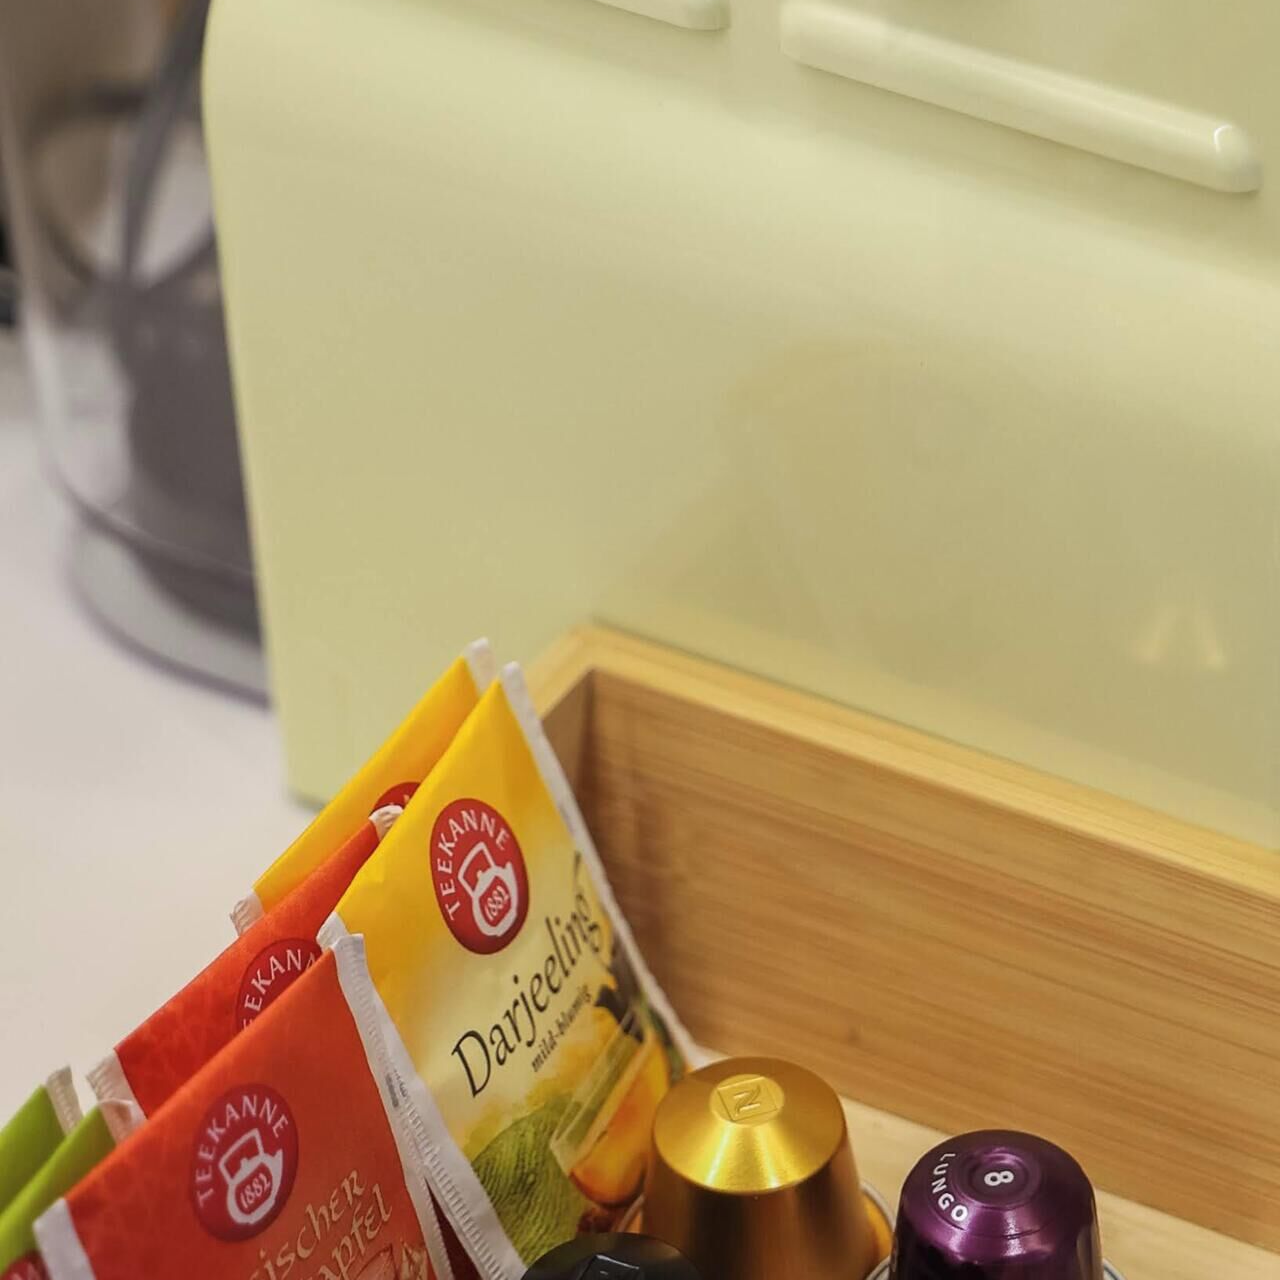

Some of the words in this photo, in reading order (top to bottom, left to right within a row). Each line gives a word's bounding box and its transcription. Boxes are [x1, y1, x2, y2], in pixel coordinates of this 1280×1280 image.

[438, 808, 510, 921] TEEKANNE
[451, 892, 600, 1099] Darjeeling
[195, 1094, 289, 1209] TEEKANNE
[240, 1172, 272, 1209] 1882
[932, 1153, 969, 1222] LUNGO
[984, 1170, 1015, 1187] 8
